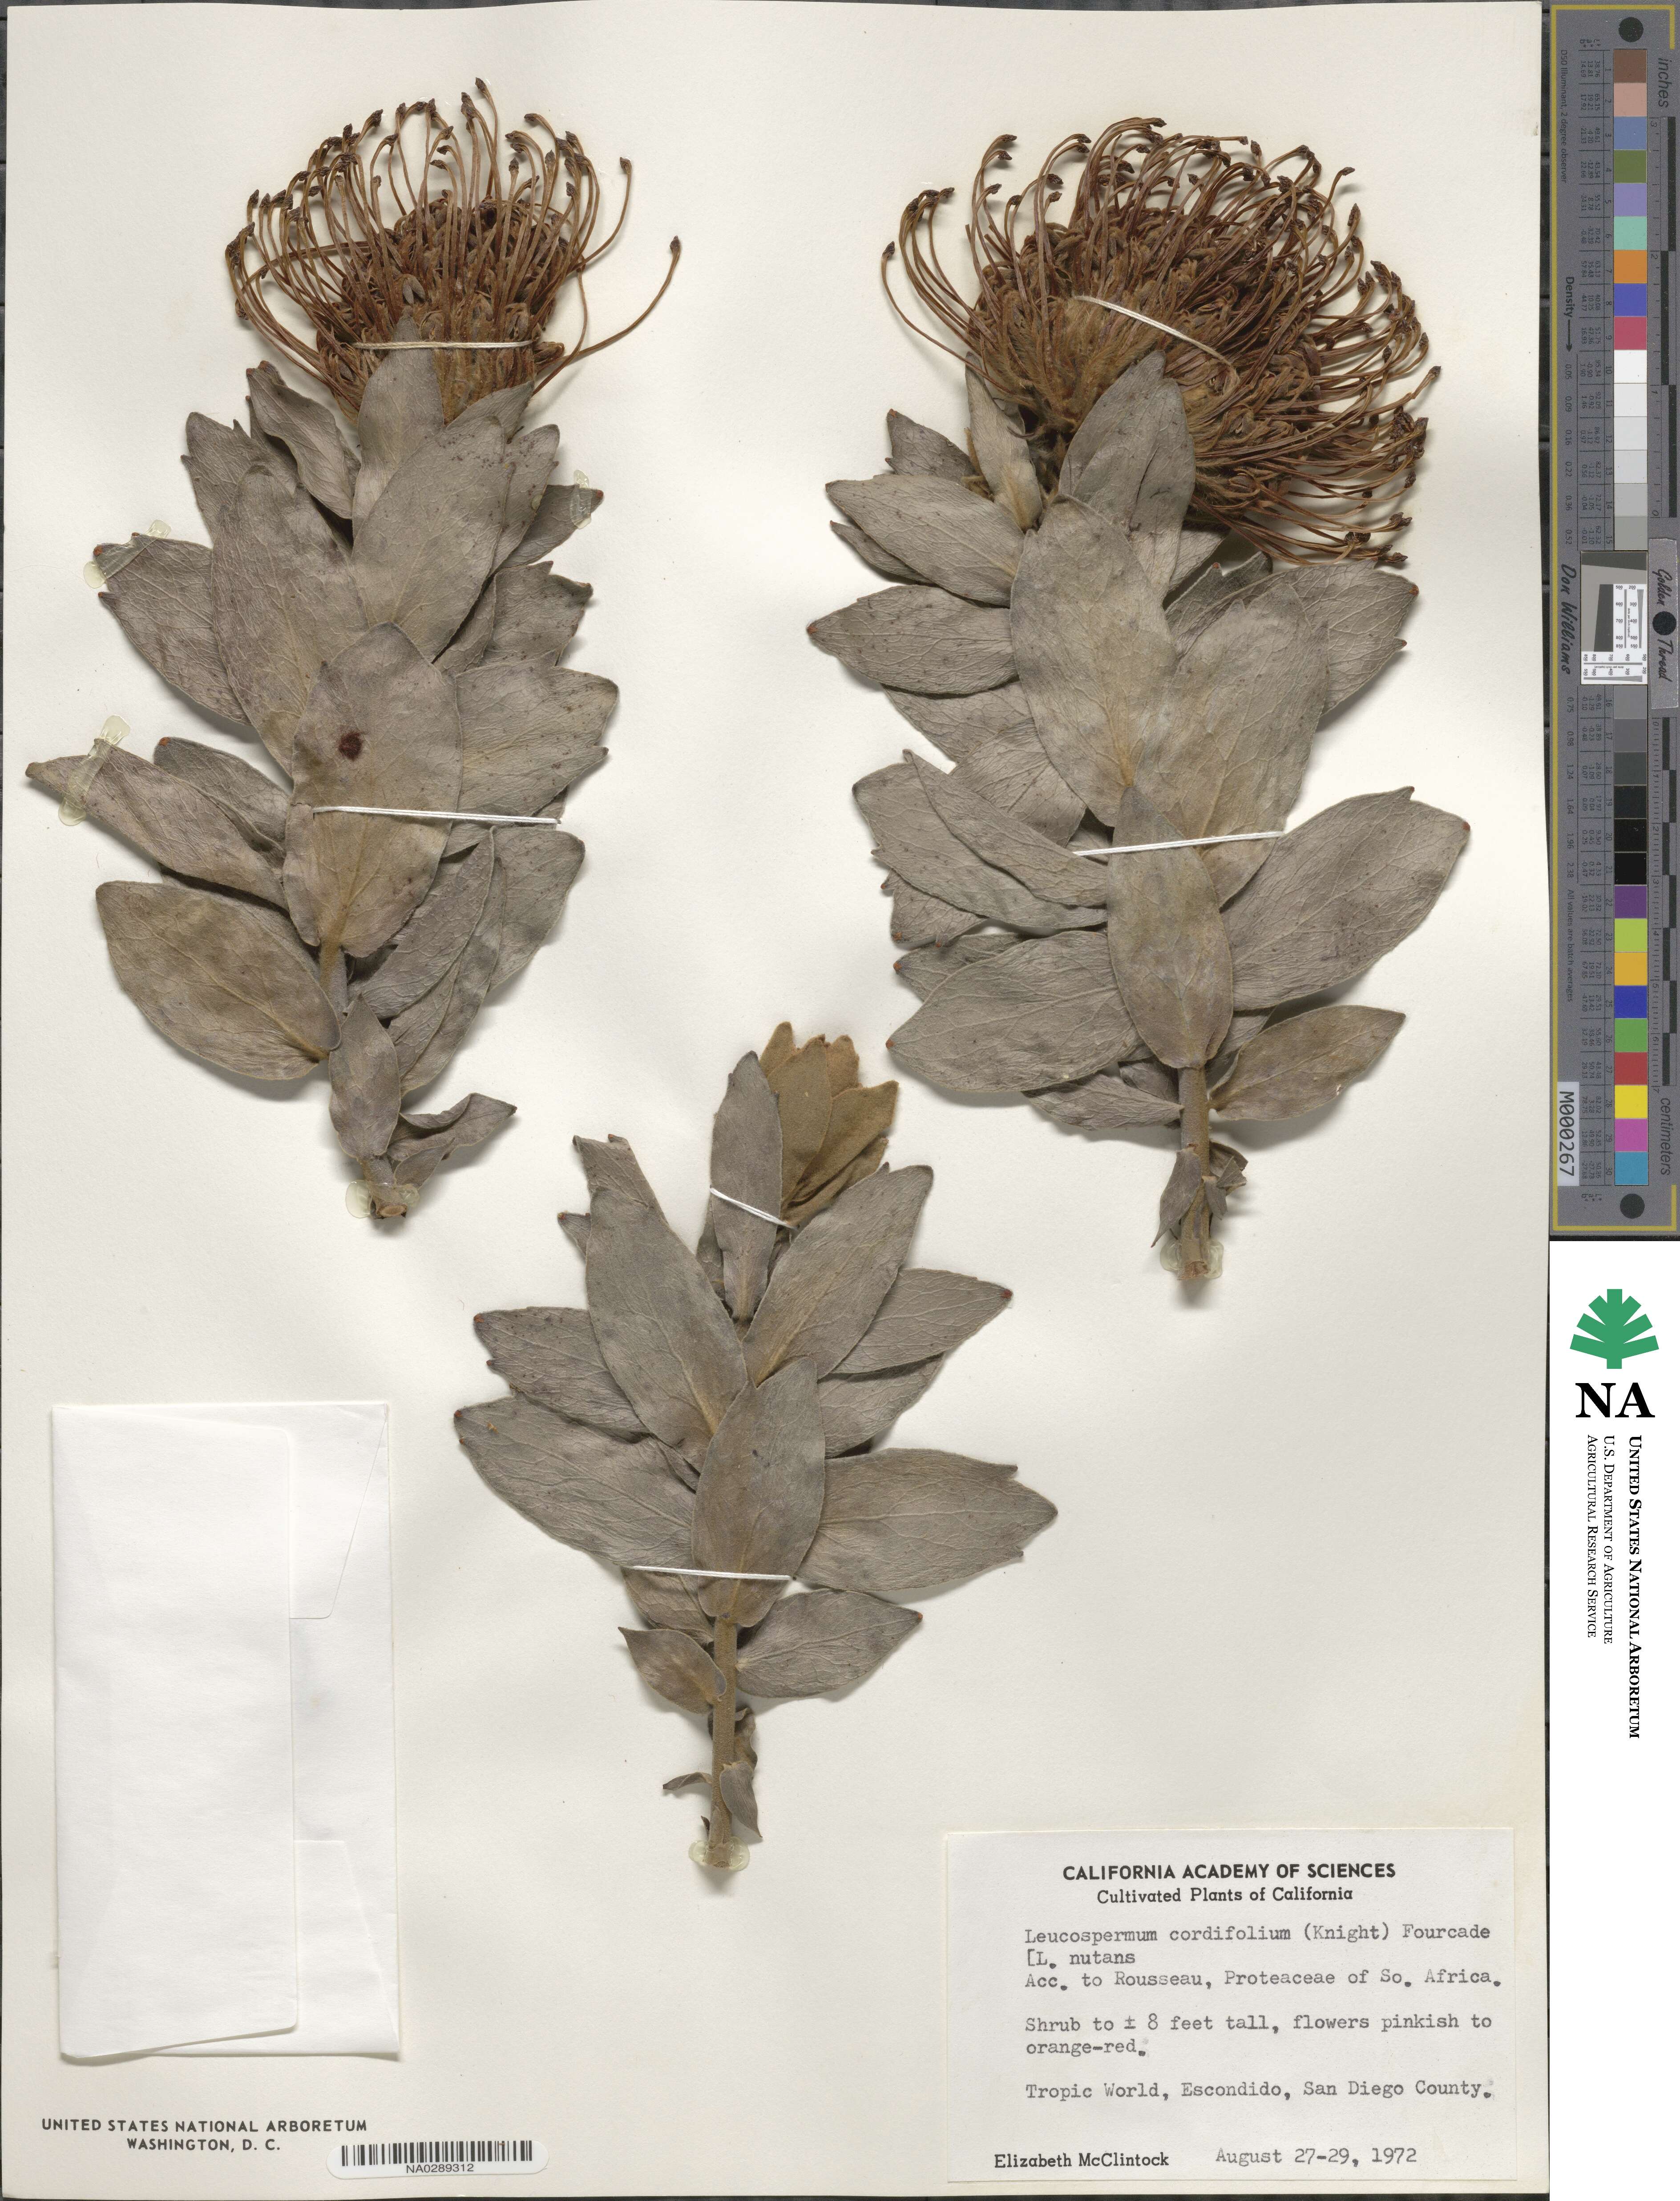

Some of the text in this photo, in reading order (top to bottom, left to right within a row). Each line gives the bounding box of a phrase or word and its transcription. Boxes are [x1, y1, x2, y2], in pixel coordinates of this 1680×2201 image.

[1658, 58, 1672, 108] inches
[1559, 119, 1568, 146] degree
[1564, 277, 1575, 317] Density
[1605, 366, 1612, 374] 10
[1606, 467, 1613, 475] 13
[1561, 564, 1578, 674] Don Williams
[1655, 569, 1673, 682] Golden Thread
[1559, 1092, 1574, 1176] M000267
[1660, 1098, 1673, 1175] centimeters
[1063, 1863, 1395, 1880] CALIFORNIA ACADEMY OF SCIENCES
[1097, 1886, 1353, 1904] Cultivated Plants of California
[1025, 1922, 1490, 1946] Leucospermum cordifolium (Knight) Fourcade
[1027, 1949, 1135, 1969] [L. nutans
[1025, 1969, 1501, 1991] Acc. to Rousseau, Proteaceae of So. Africa.
[1026, 2013, 1491, 2034] Shrub to ± 8 feet tall, flowers pinkish to
[1026, 2039, 1146, 2057] orange-red.
[1026, 2080, 1491, 2101] Tropic World, Escondido, San Diego County.
[42, 2119, 366, 2132] UNITED STATES NATIONAL ARBORETUM
[127, 2138, 280, 2152] WASHINGTON, D. C.
[994, 2152, 1169, 2168] Elizabeth McClintock
[1216, 2148, 1417, 2167] August 27-29, 1972
[407, 2164, 473, 2173] NA0289312
